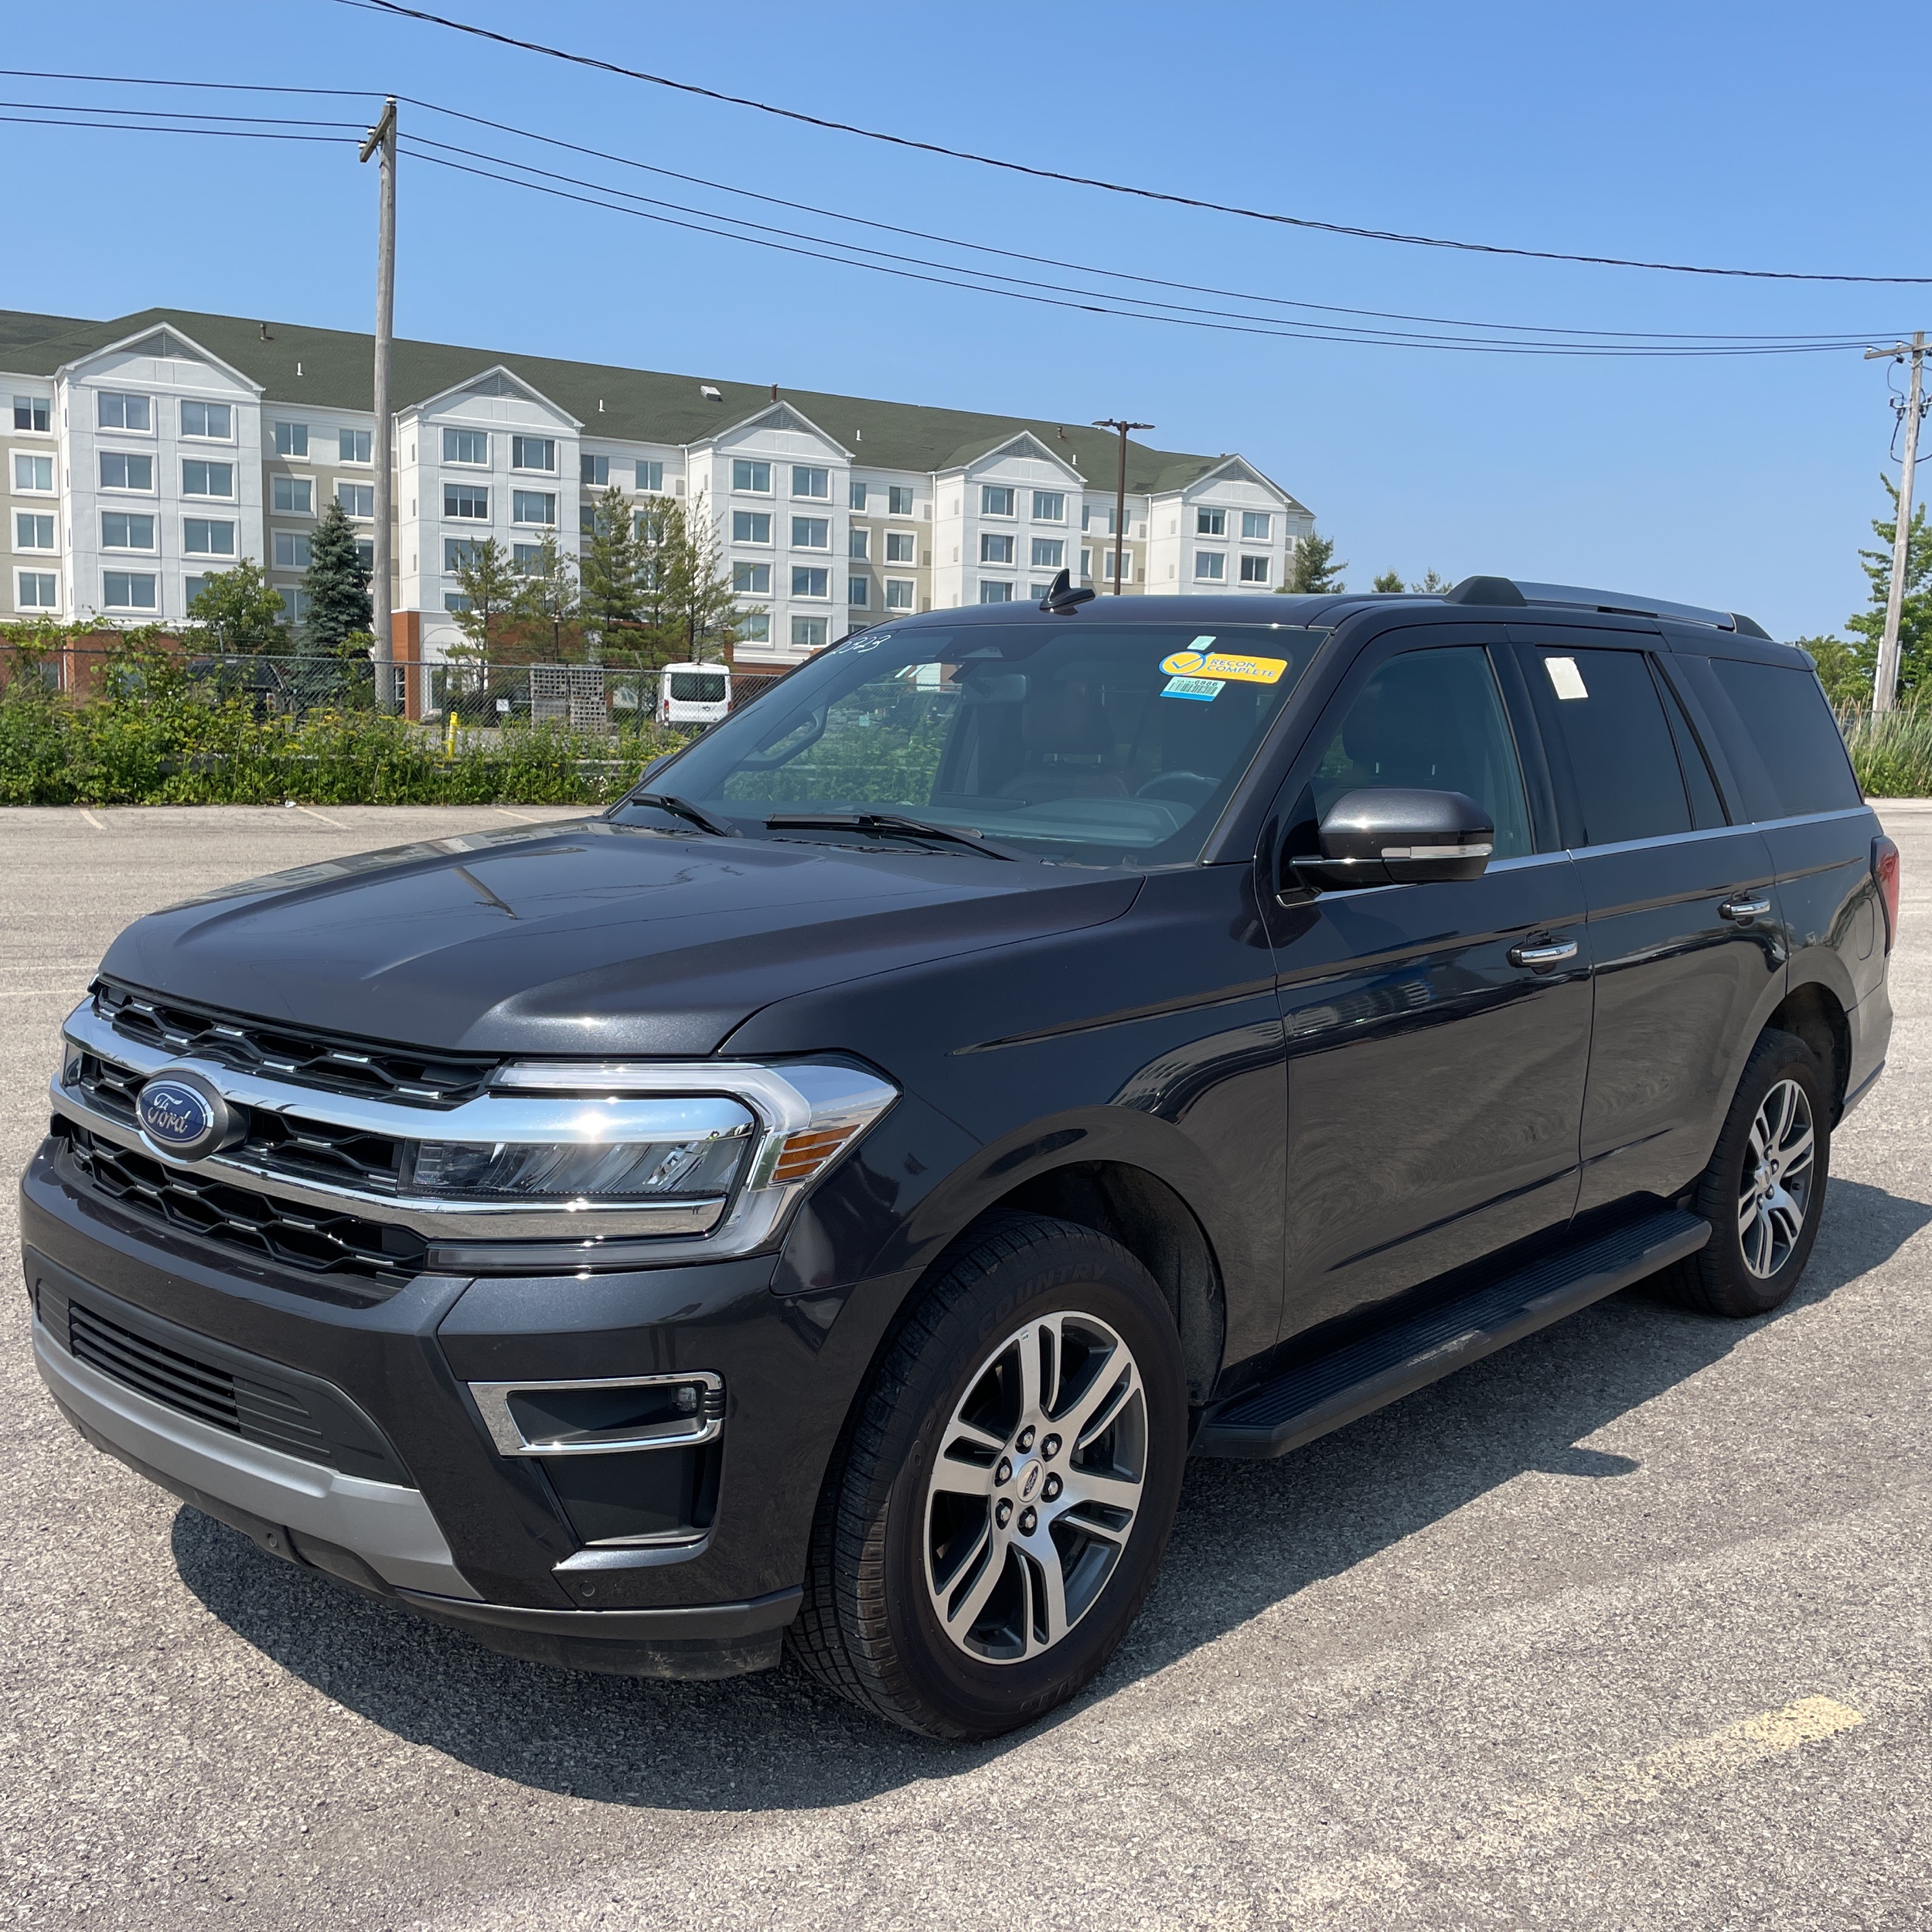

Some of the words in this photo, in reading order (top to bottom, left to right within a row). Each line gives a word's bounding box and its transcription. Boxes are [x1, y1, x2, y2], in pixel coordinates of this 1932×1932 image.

[1210, 659, 1257, 668] RECON
[1207, 665, 1276, 677] COMPLETE
[148, 1092, 192, 1134] Ford
